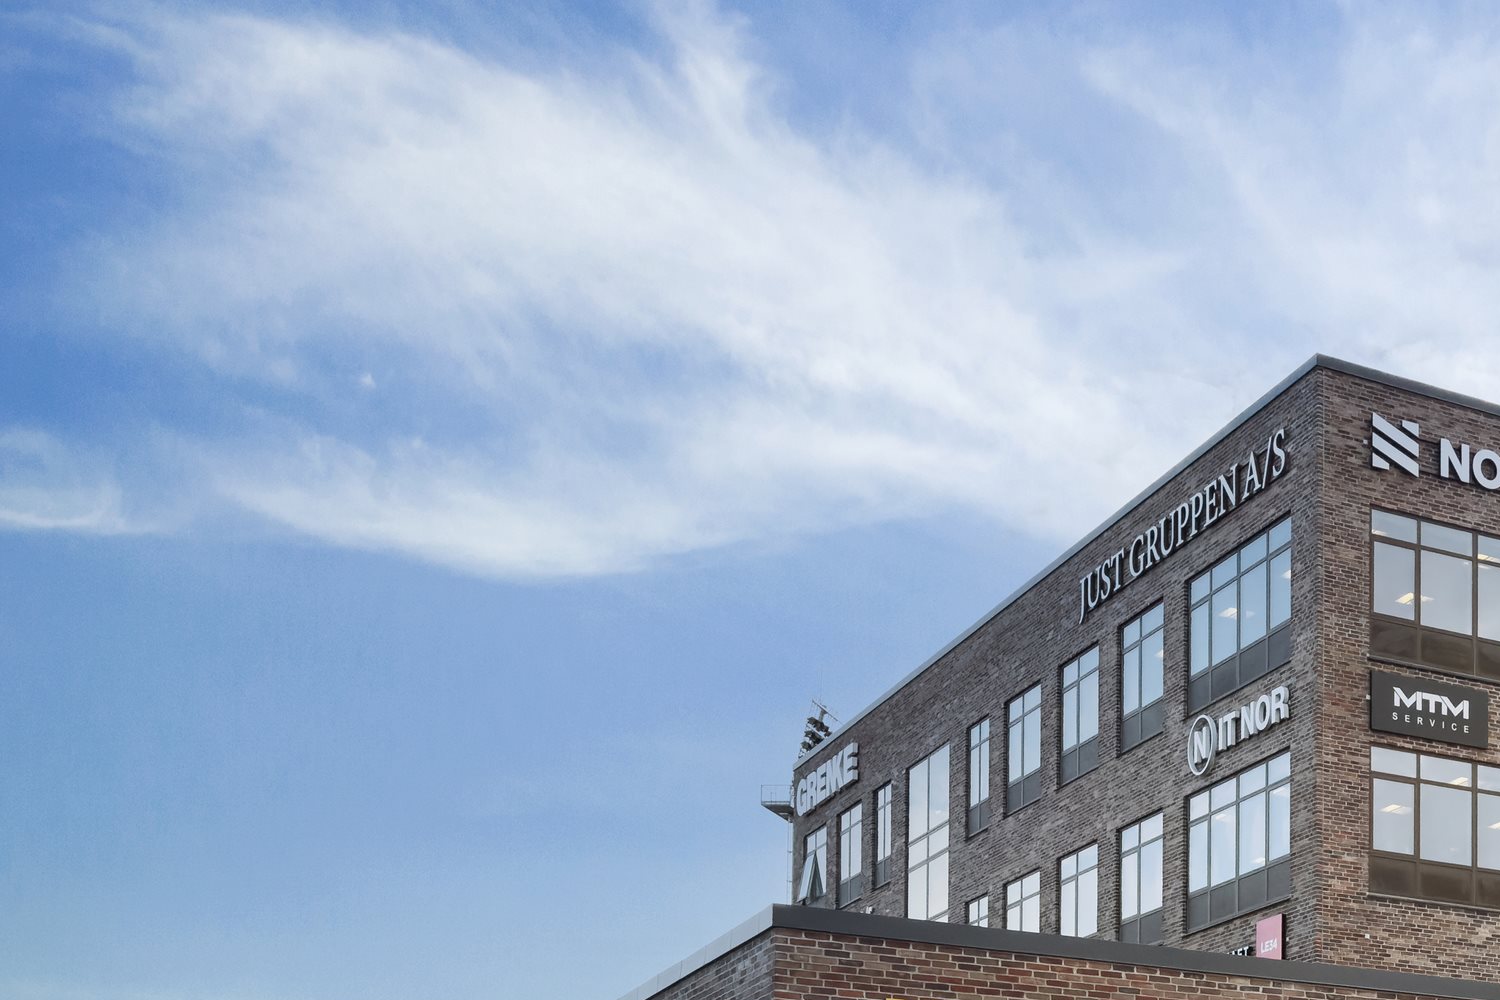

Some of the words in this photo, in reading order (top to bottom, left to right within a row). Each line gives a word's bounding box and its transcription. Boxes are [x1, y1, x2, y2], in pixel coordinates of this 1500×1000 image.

[1078, 547, 1125, 625] JUST
[1128, 463, 1239, 578] GRUPPEN
[1241, 428, 1287, 501] A/S
[1218, 710, 1240, 751] IT
[1241, 685, 1290, 740] NOR
[1392, 712, 1470, 733] SERVICE
[1393, 686, 1470, 720] MTM
